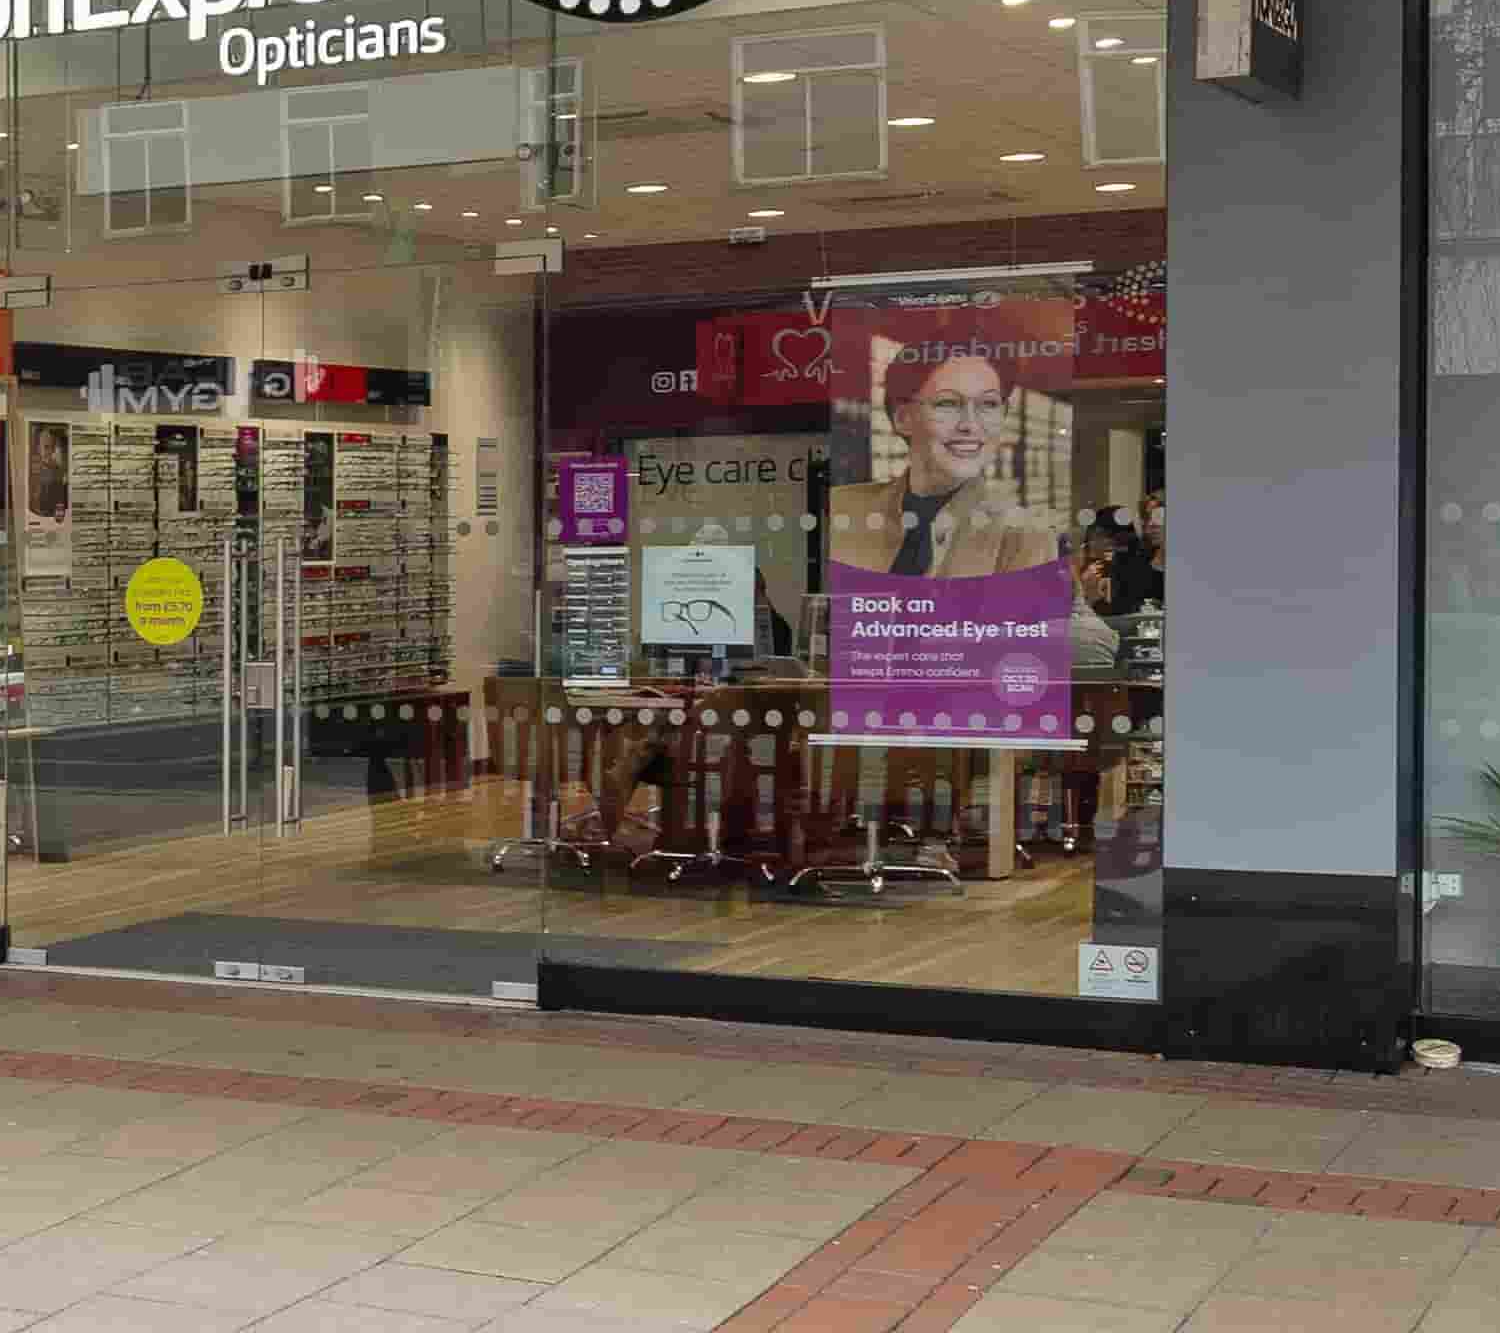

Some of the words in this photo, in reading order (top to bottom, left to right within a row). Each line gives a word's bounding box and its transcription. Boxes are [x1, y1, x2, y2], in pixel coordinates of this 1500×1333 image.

[219, 16, 446, 85] Opticians
[639, 455, 694, 494] Eye
[705, 459, 776, 483] care
[851, 597, 903, 613] Book
[907, 599, 935, 613] an
[851, 621, 958, 638] Advanced
[963, 622, 1000, 643] Eye
[1004, 621, 1049, 637] Test
